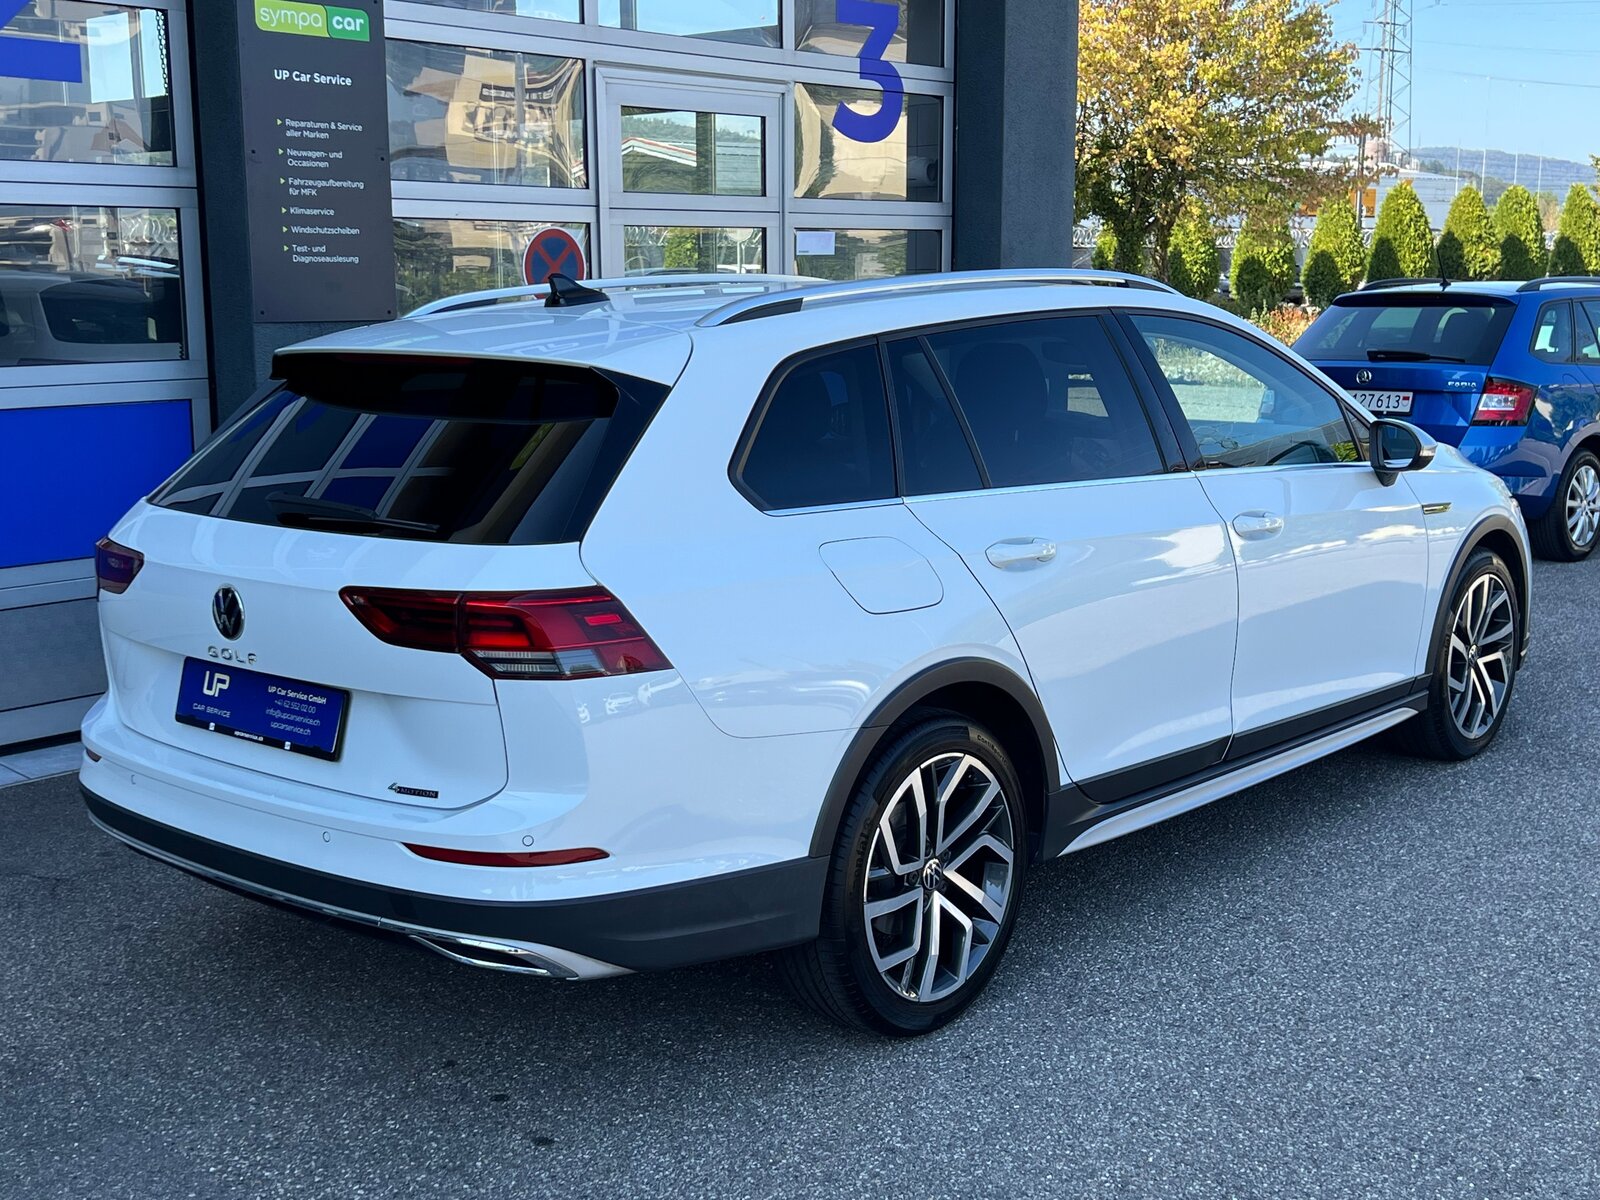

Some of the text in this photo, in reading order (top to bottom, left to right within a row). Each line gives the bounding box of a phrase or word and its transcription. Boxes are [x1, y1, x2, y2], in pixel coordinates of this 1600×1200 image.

[260, 7, 364, 32] sympa car
[274, 69, 352, 86] UP Car Service
[832, 0, 904, 143] 3
[285, 118, 363, 132] Reparaturen & Service
[286, 130, 329, 139] aller Marken
[287, 148, 343, 159] Neuwagen- und
[287, 159, 329, 168] Occasionen
[288, 178, 364, 190] Fahrzeugaufbereitung
[289, 187, 317, 196] für MFK
[290, 207, 335, 216] Klimaservice
[291, 226, 360, 235] Windschutzscheiben
[292, 244, 326, 253] Test- und
[292, 254, 359, 264] Diagnoseauslesung
[208, 645, 257, 665] GOLF
[202, 670, 230, 697] UP
[268, 685, 327, 704] UP Car Service GmbH
[192, 702, 231, 718] CAR SERVICE
[270, 721, 311, 735] upcarservice.ch
